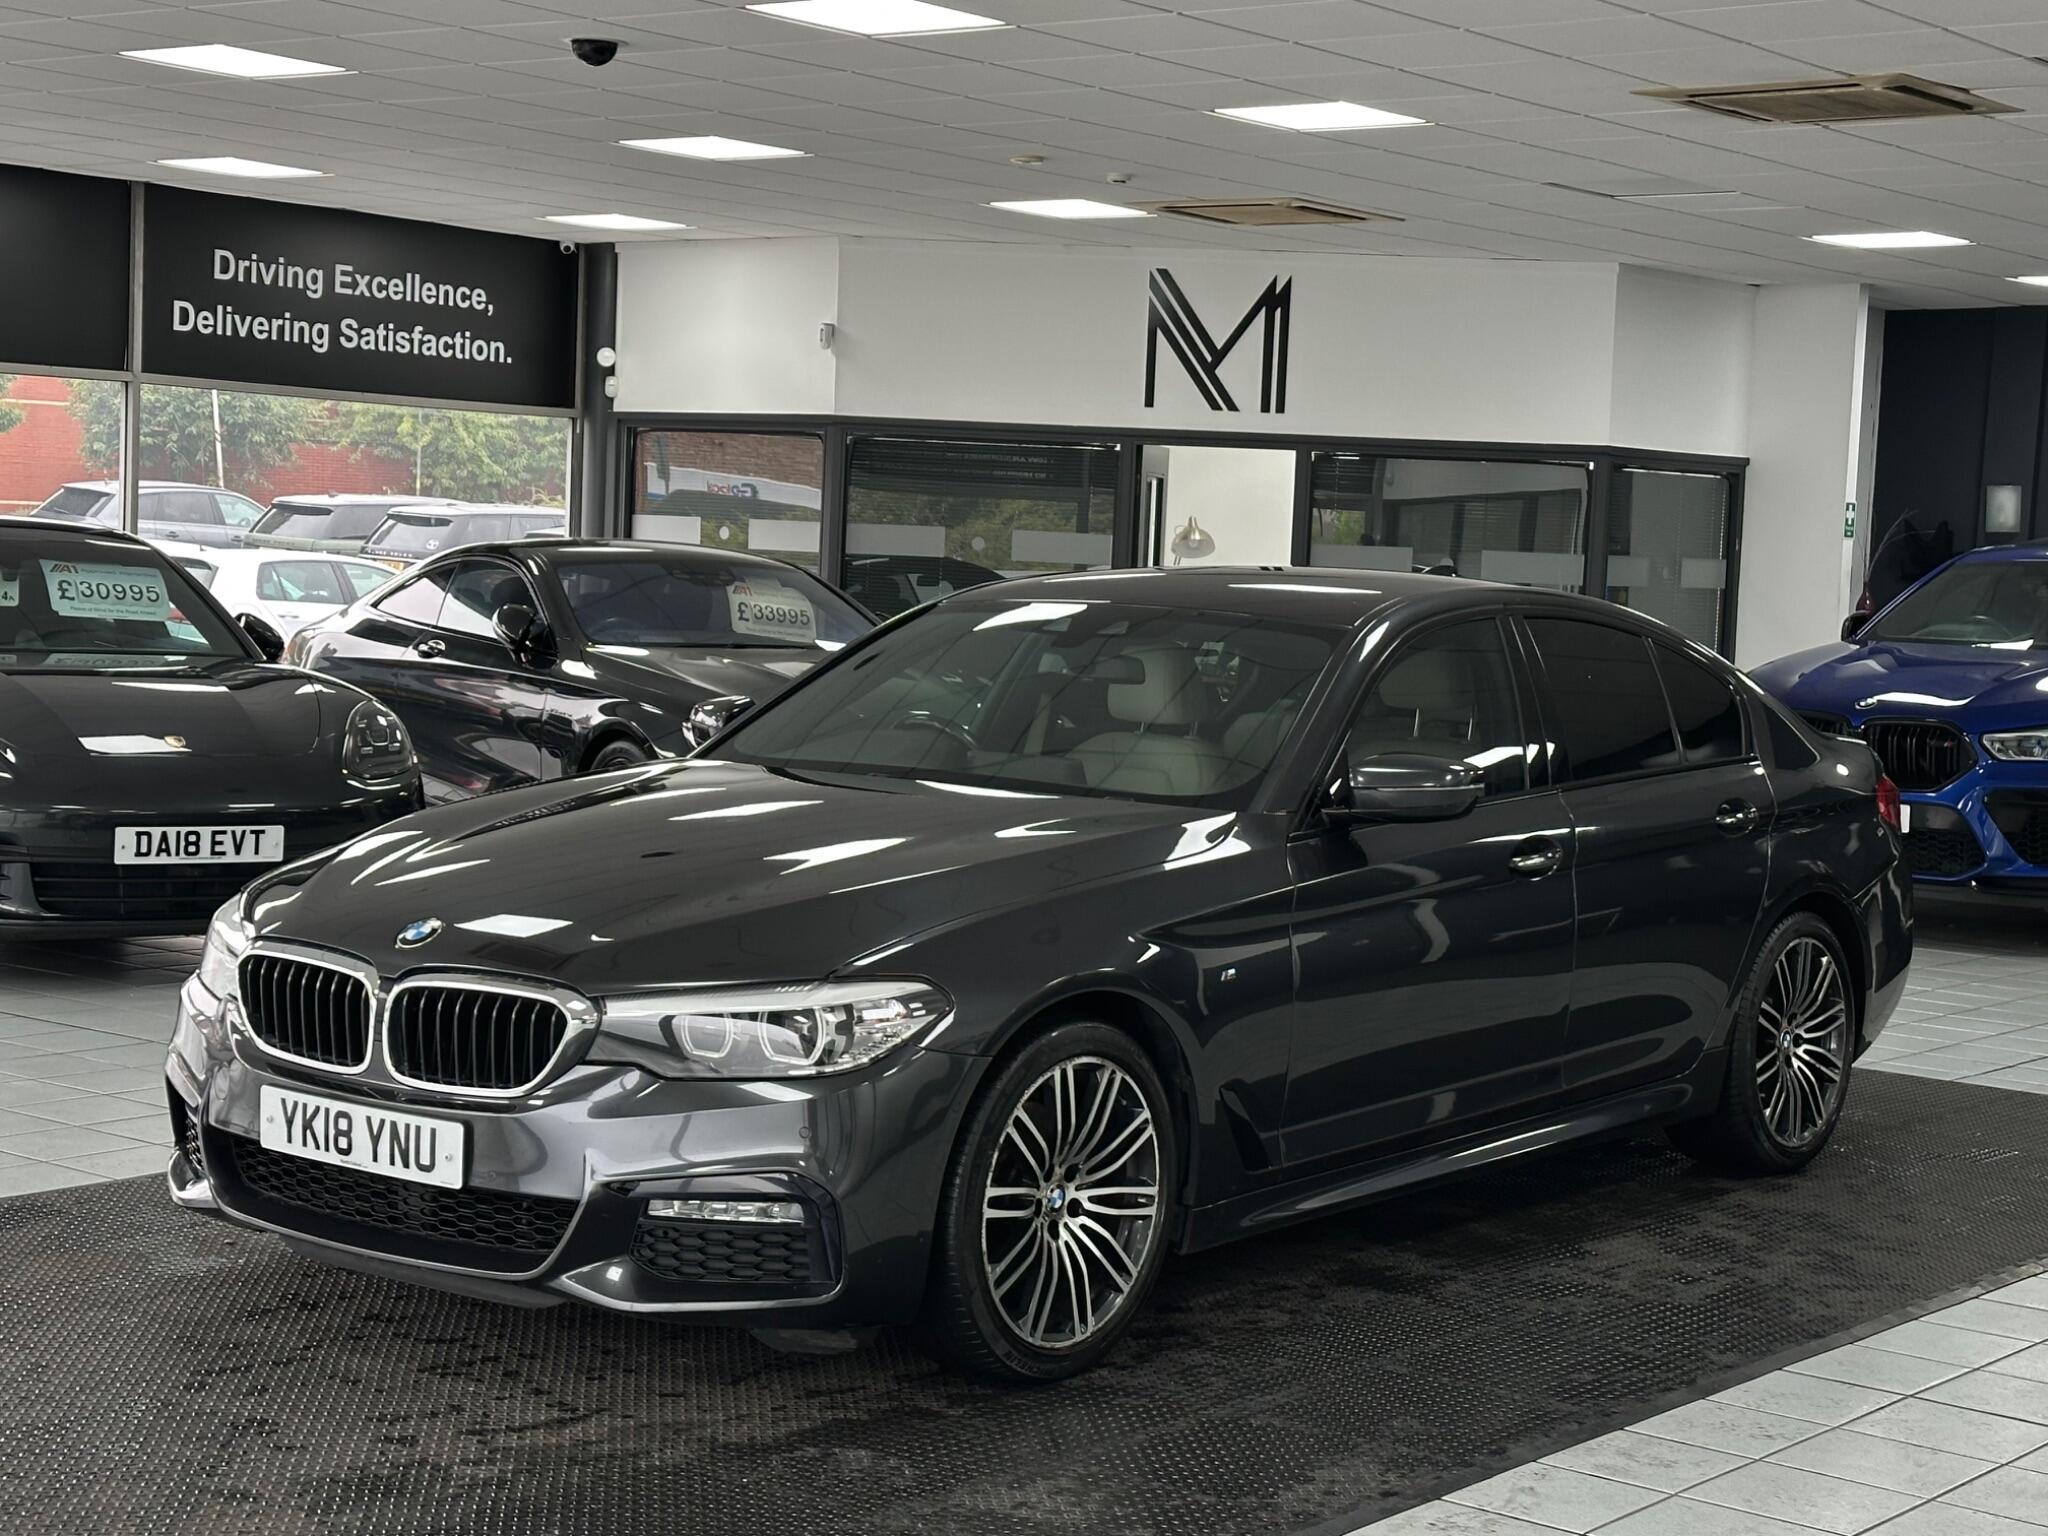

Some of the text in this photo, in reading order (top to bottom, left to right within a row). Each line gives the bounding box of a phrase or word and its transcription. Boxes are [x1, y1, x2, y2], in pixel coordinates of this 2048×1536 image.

[213, 248, 495, 316] Driving Excellence,
[172, 300, 513, 364] Delivering Satisfaction.
[57, 579, 160, 603] £30995
[737, 601, 811, 626] £33995
[134, 829, 266, 857] DA18 EVT
[280, 1097, 437, 1174] YK18 YNU
